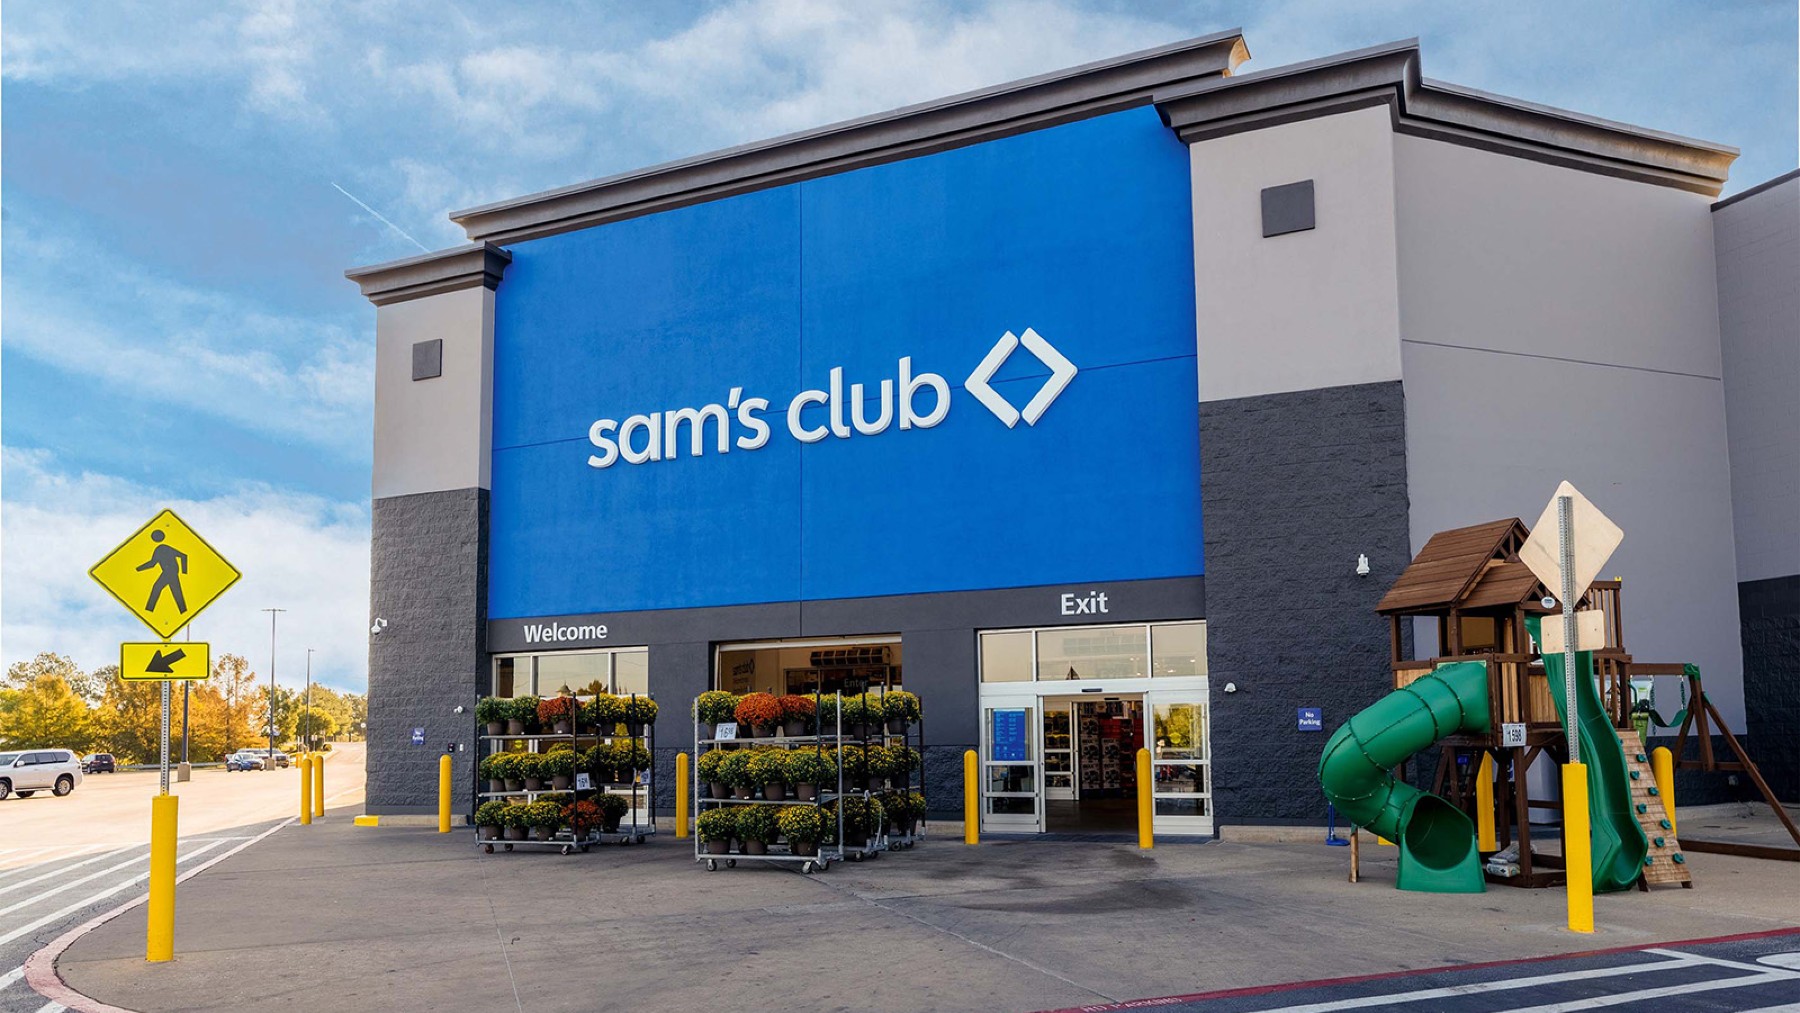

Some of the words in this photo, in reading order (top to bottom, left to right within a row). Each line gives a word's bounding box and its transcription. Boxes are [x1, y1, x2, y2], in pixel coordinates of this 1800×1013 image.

[587, 386, 771, 469] sam's
[786, 355, 952, 444] club
[1061, 590, 1109, 616] Exit
[523, 622, 609, 643] Welcome
[1299, 718, 1321, 726] Parking
